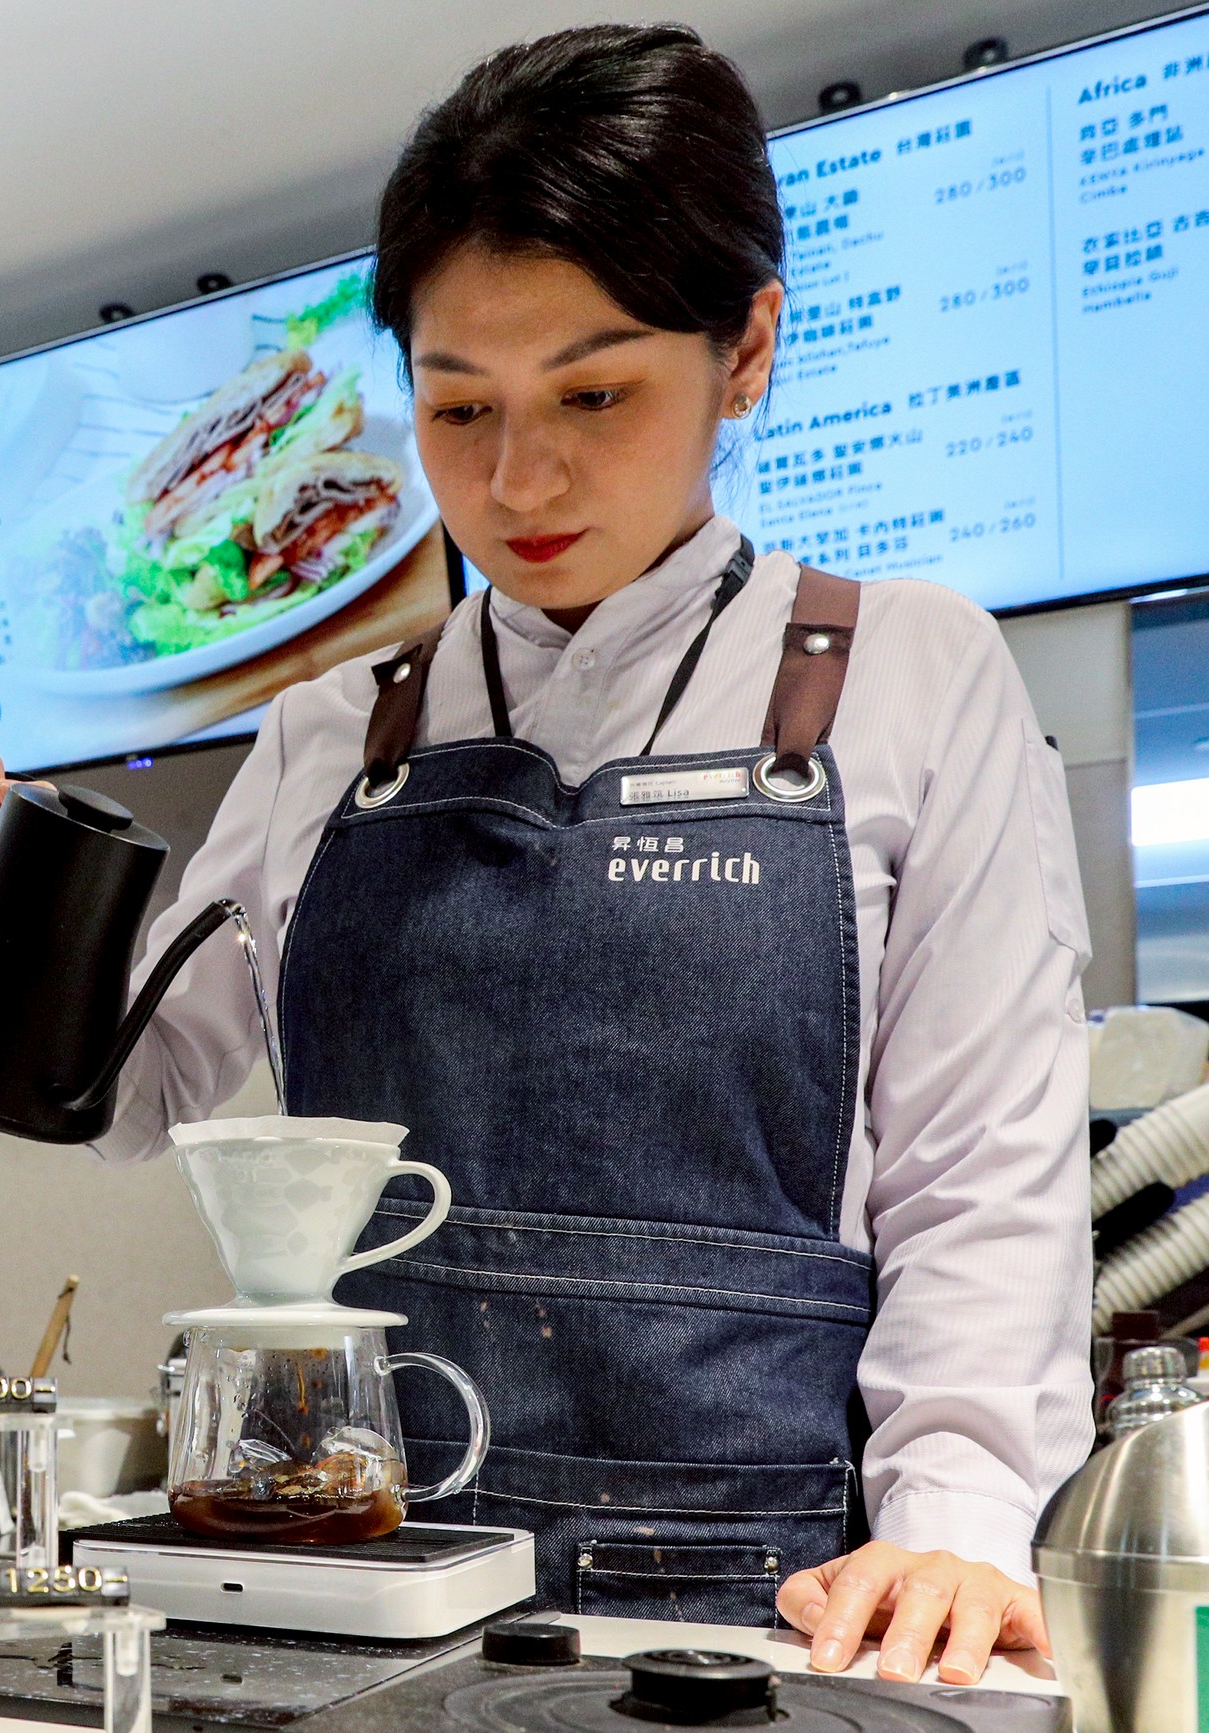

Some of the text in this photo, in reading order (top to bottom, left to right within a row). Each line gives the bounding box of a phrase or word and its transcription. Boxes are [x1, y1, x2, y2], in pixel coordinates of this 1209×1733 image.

[1163, 52, 1209, 79] 非洲
[1078, 74, 1147, 105] Africa
[816, 149, 882, 179] Estate
[755, 400, 893, 441] Latin America
[668, 789, 690, 798] Lisa
[608, 851, 760, 884] everrich
